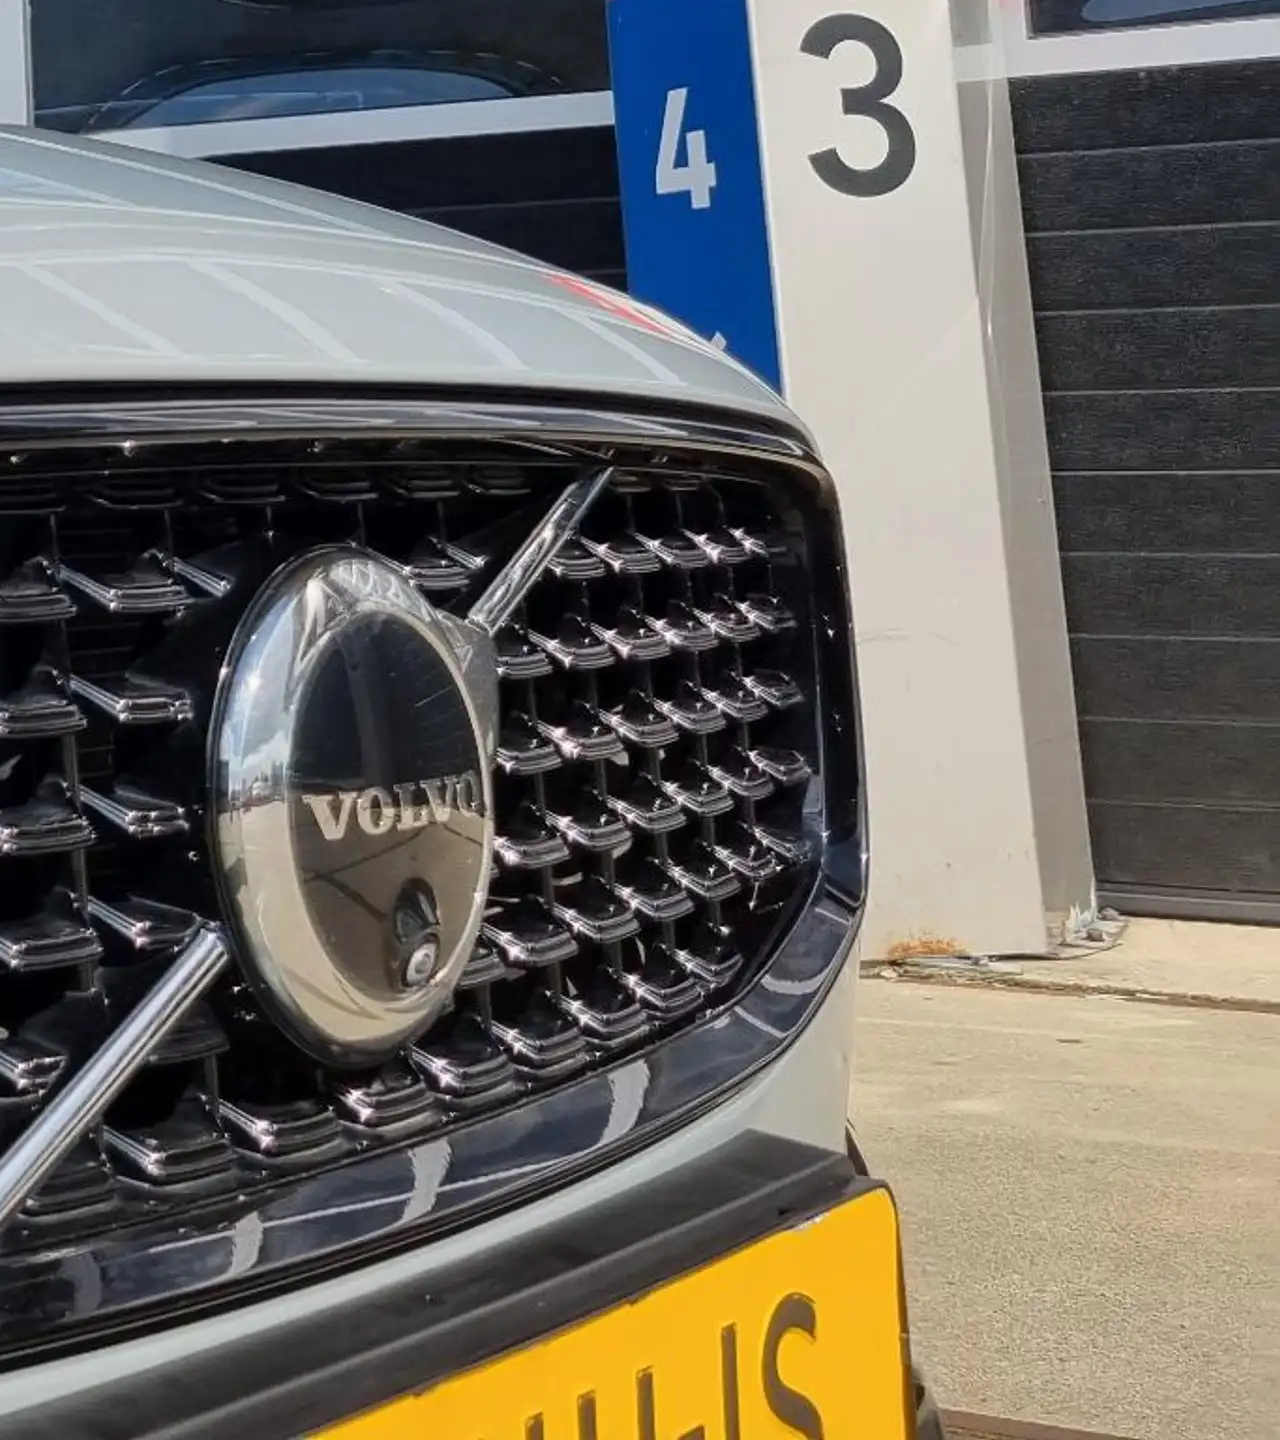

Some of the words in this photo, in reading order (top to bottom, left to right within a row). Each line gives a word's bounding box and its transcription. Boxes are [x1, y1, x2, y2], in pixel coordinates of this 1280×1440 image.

[655, 87, 716, 209] 4
[799, 13, 916, 197] 3
[302, 770, 483, 841] VOLVO
